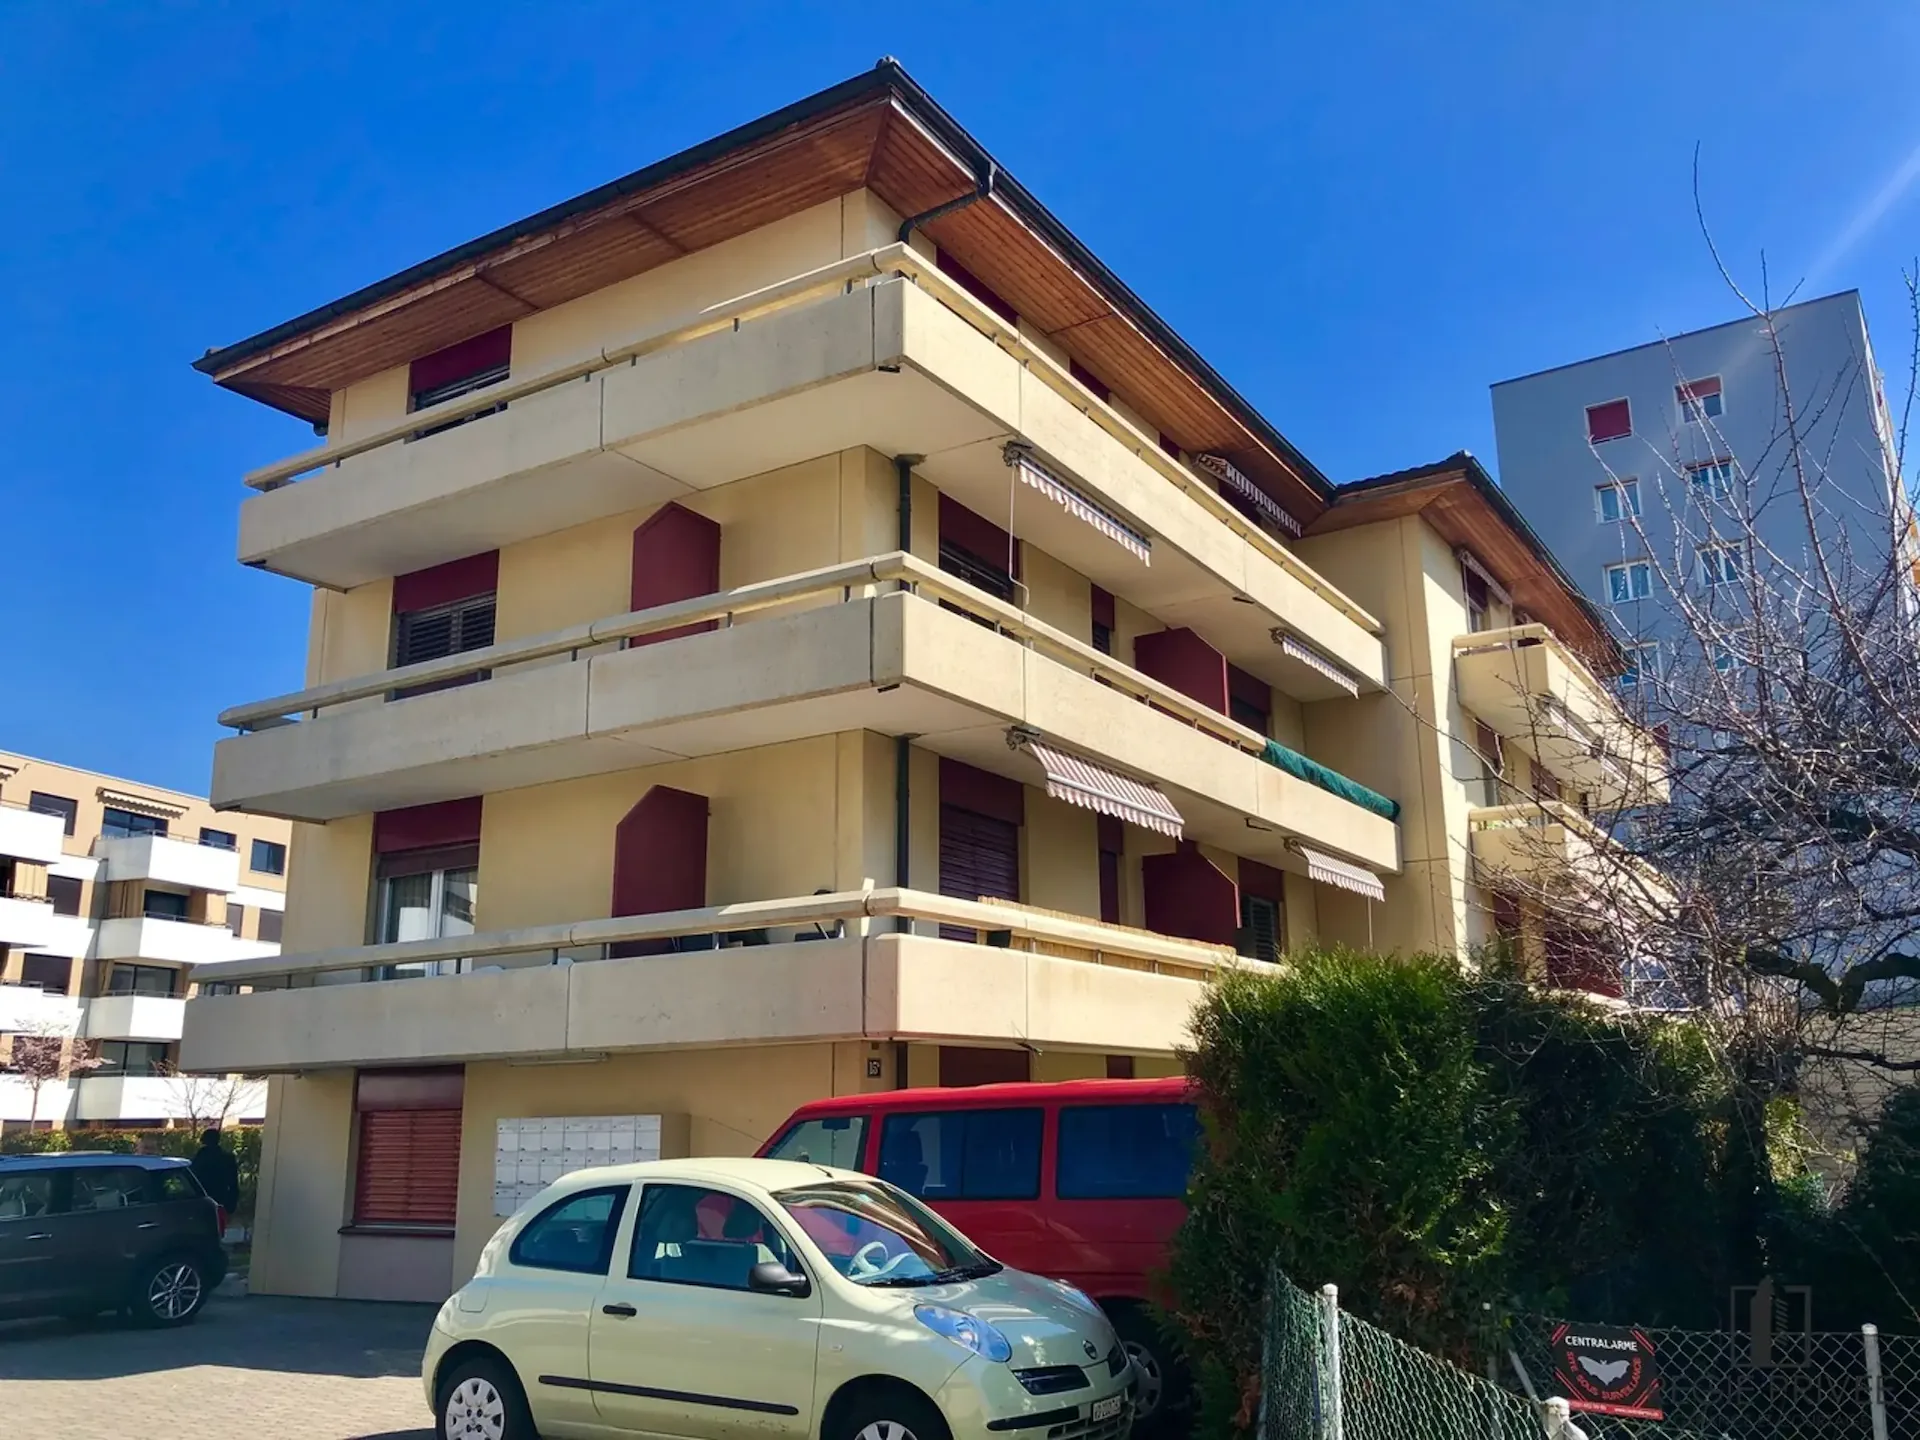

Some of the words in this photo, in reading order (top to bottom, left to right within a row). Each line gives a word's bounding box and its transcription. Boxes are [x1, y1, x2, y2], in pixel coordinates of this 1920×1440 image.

[1564, 1335, 1638, 1352] CENTRALARME
[1567, 1351, 1578, 1372] SITE
[1576, 1373, 1599, 1396] SOUS
